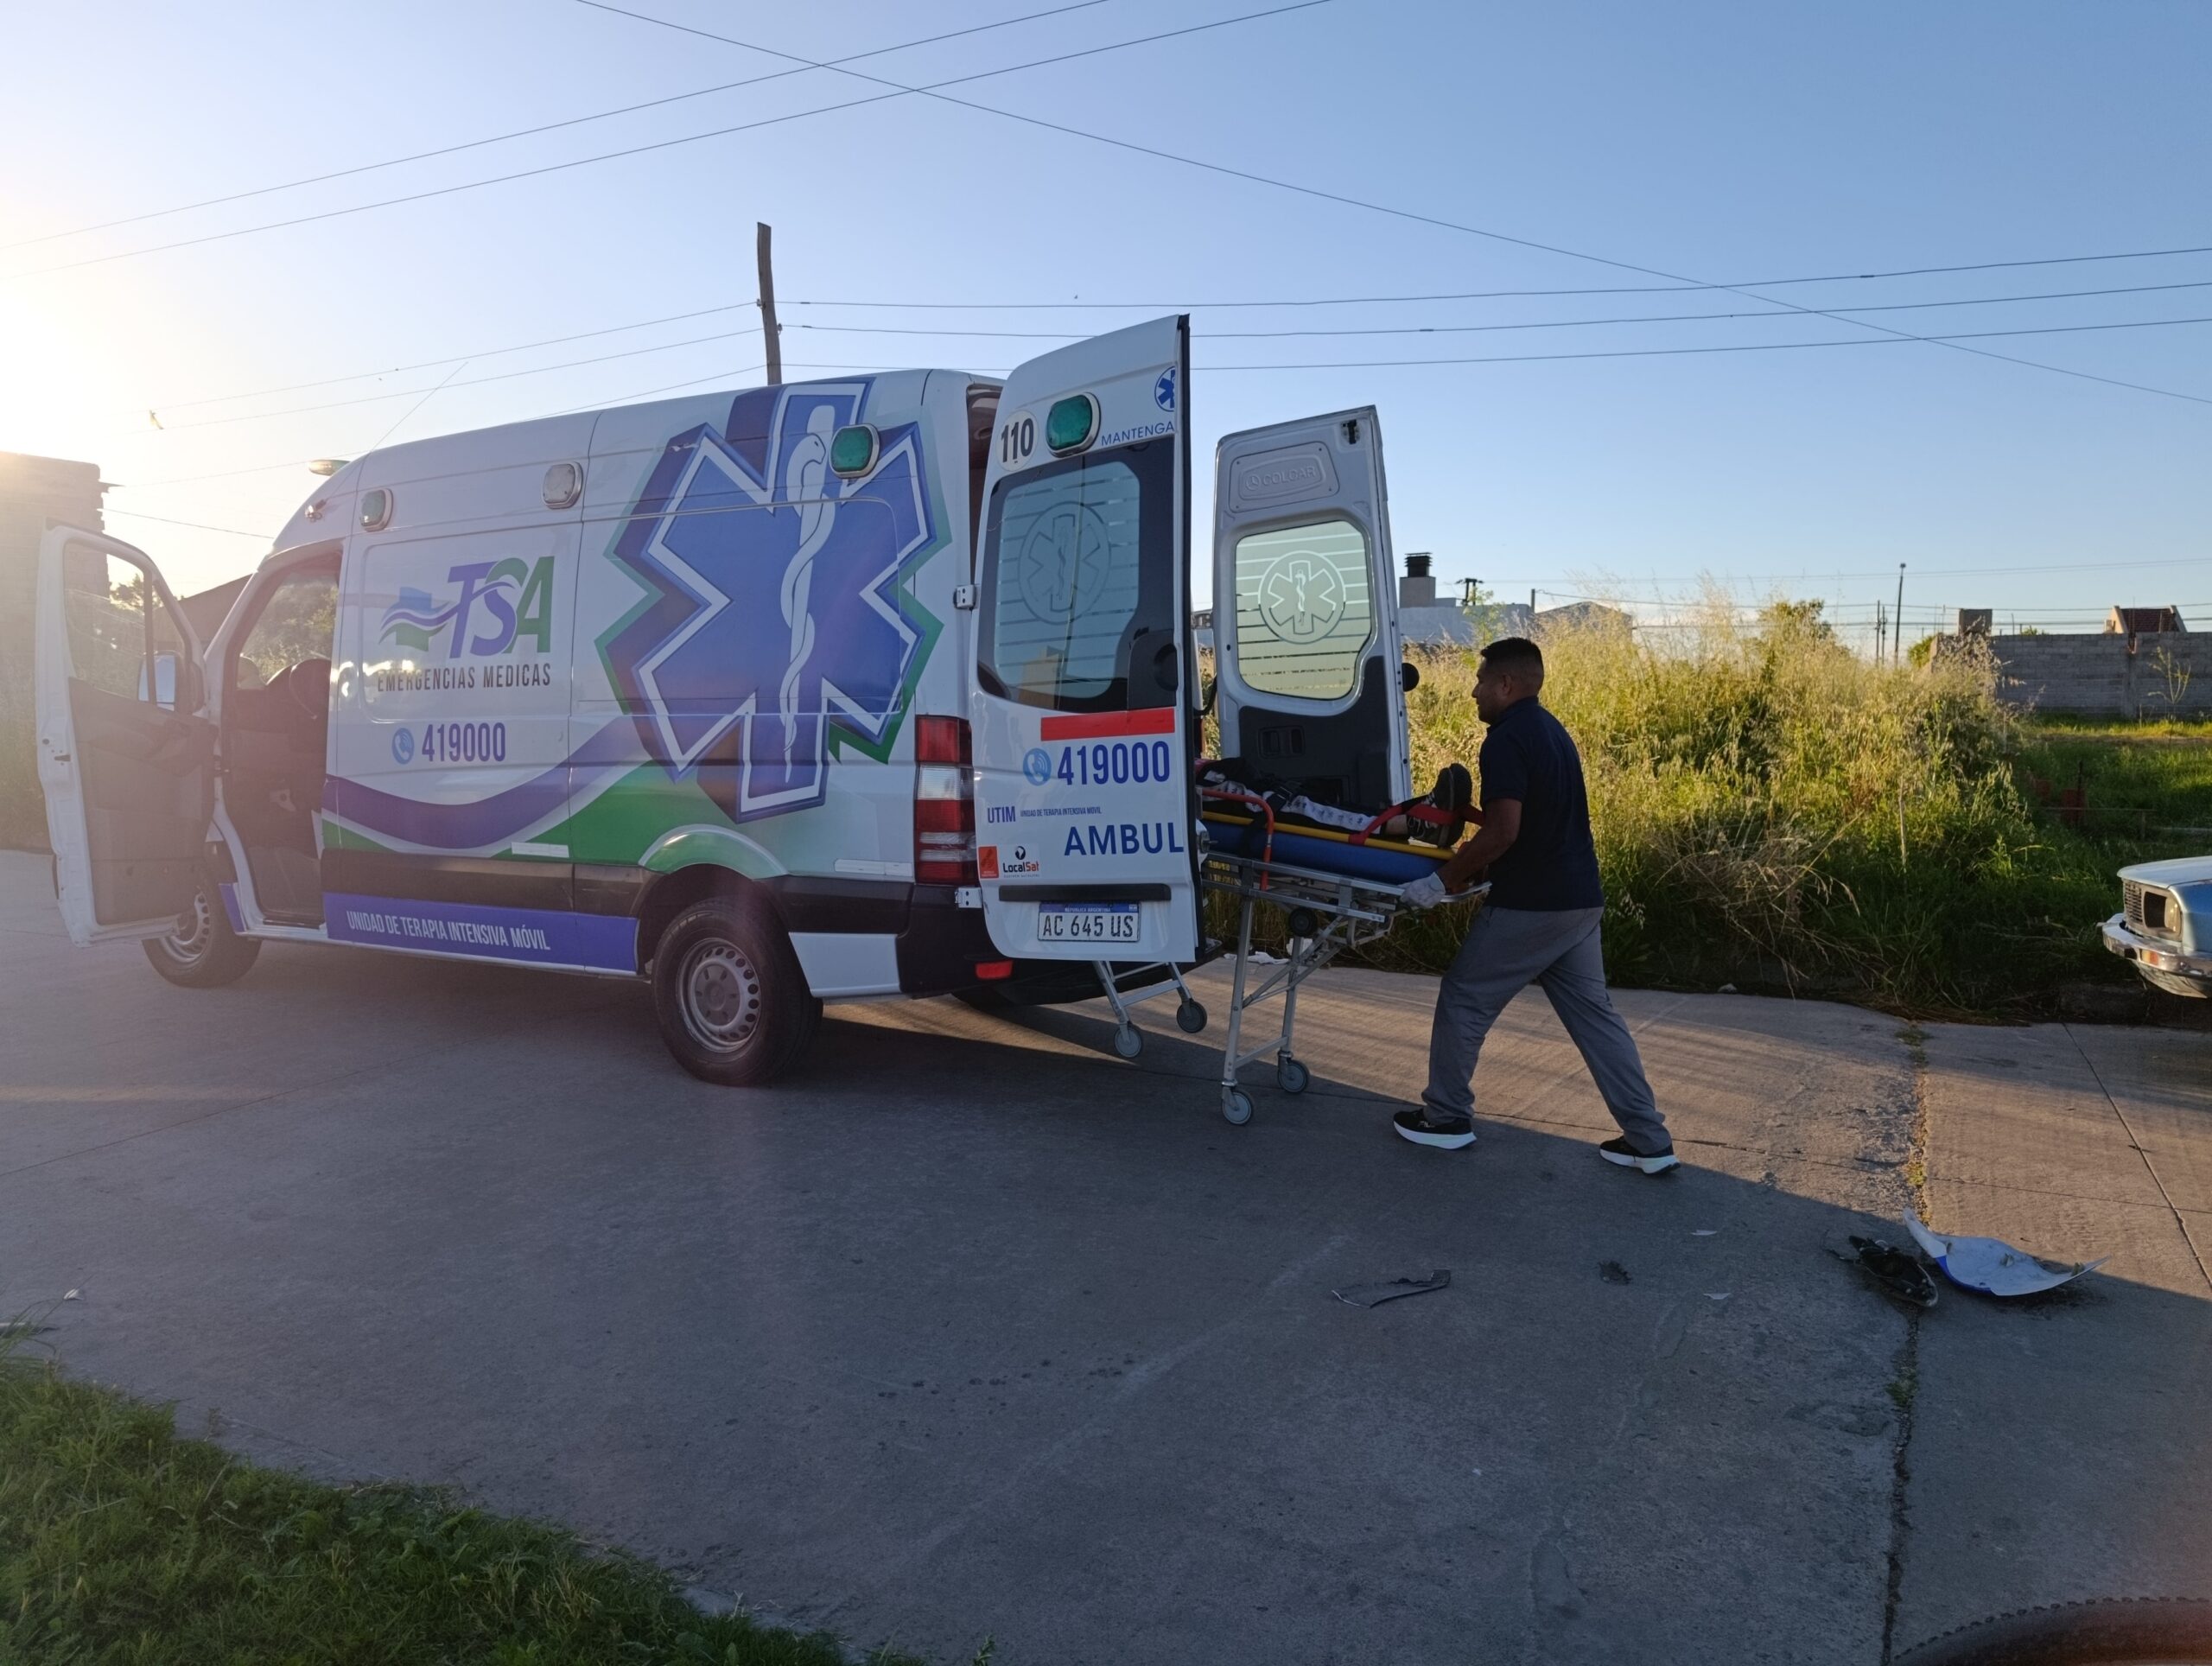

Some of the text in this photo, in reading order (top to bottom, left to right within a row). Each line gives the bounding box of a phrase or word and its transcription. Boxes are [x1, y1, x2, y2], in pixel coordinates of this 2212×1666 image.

[1001, 417, 1034, 463] 110
[1101, 420, 1175, 446] MANTENGA
[447, 556, 555, 658] TSA
[377, 662, 551, 692] EMERGENCIAS MEDICAS
[421, 722, 506, 762] 419000
[1057, 741, 1170, 785] 419000
[987, 805, 1016, 823] UTIM
[1064, 822, 1185, 856] AMBUL
[1002, 861, 1039, 873] LocalSat
[346, 910, 551, 951] UNIDAD DE TERAPIA INTENSIVA MÓVIL
[1043, 915, 1134, 938] AC 645 US
